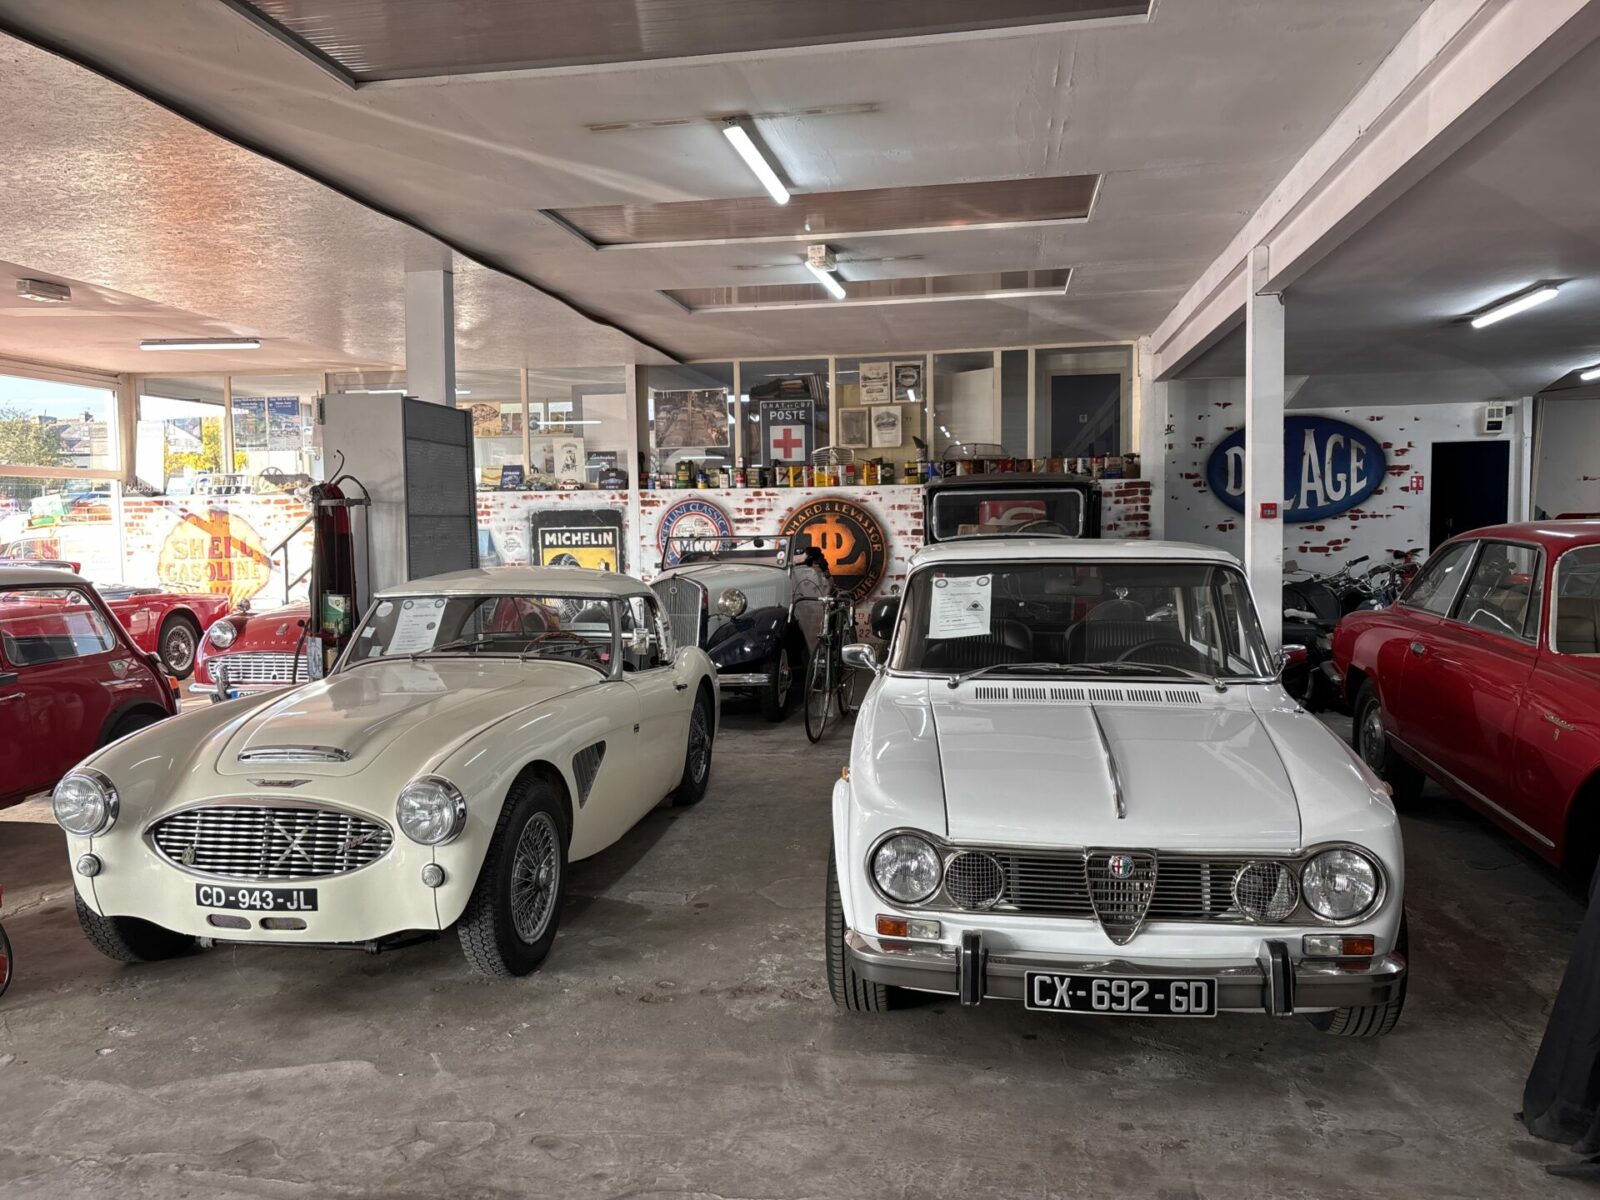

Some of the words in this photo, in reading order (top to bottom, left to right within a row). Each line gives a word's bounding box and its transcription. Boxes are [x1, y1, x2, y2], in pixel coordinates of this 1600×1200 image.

[769, 410, 806, 420] POSTE
[689, 503, 726, 528] CLASSIC
[544, 531, 613, 546] MICHELIN
[834, 503, 882, 552] LEVASSOR
[171, 536, 253, 559] SHELL
[164, 560, 261, 582] GASOLINE
[200, 886, 312, 910] CD-943-JL
[1033, 975, 1208, 1013] CX-692-GD
